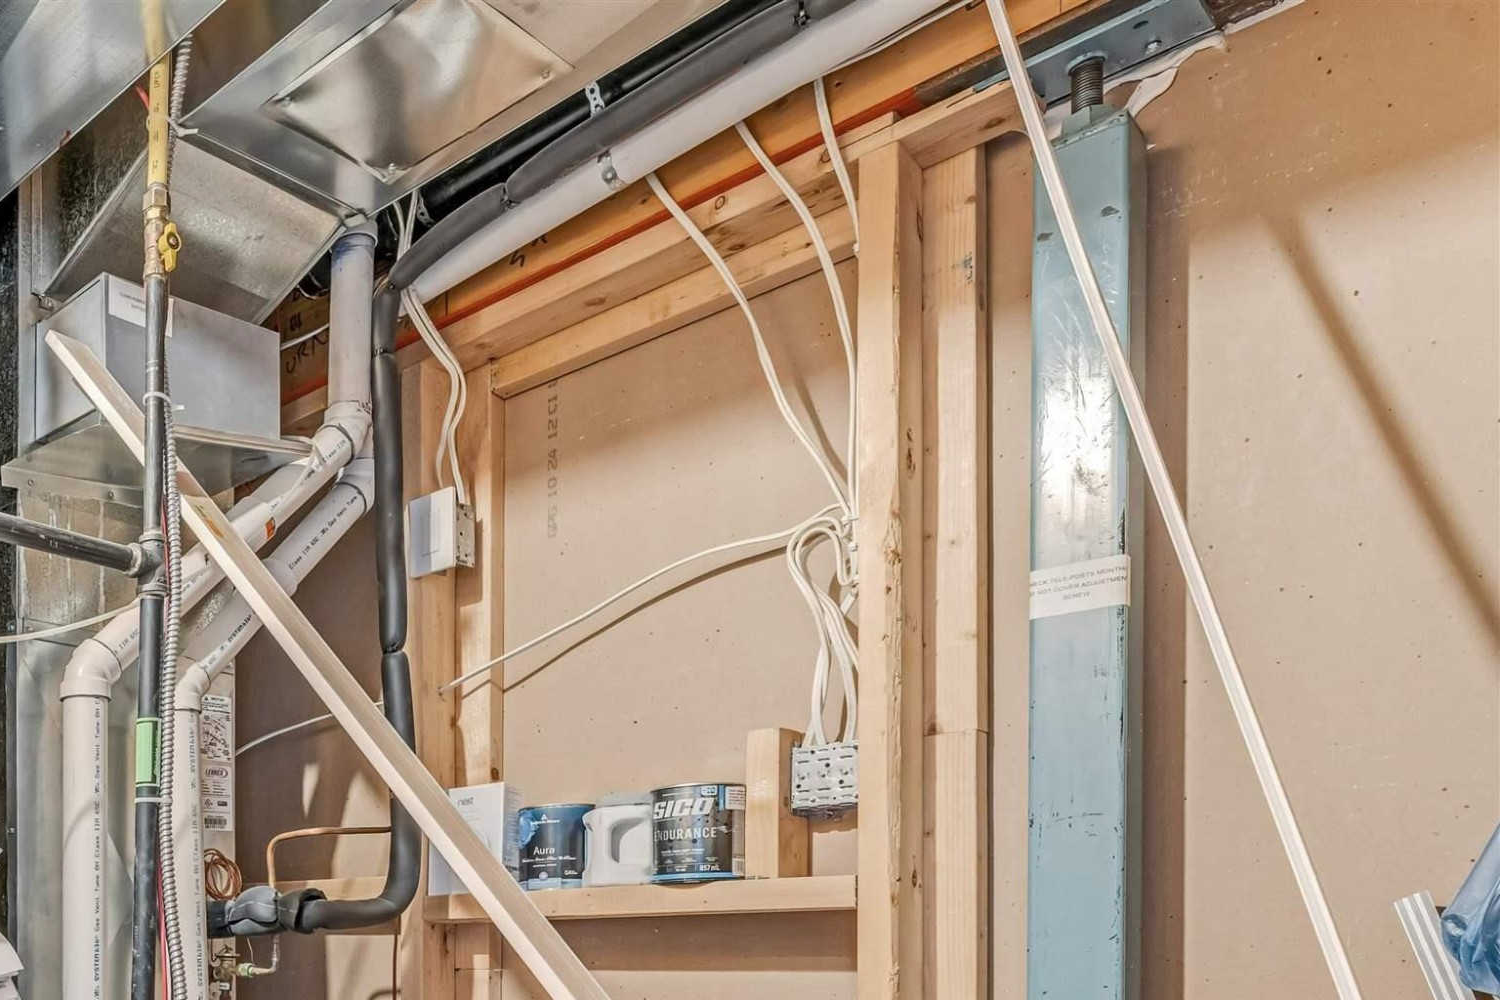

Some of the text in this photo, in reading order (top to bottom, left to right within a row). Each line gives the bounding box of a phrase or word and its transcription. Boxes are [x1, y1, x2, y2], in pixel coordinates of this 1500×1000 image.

[1081, 575, 1127, 588] ADJUSTMEN
[458, 797, 474, 806] nest
[653, 798, 715, 819] SICO
[654, 827, 717, 842] ENDURANCE
[533, 846, 555, 855] Aura
